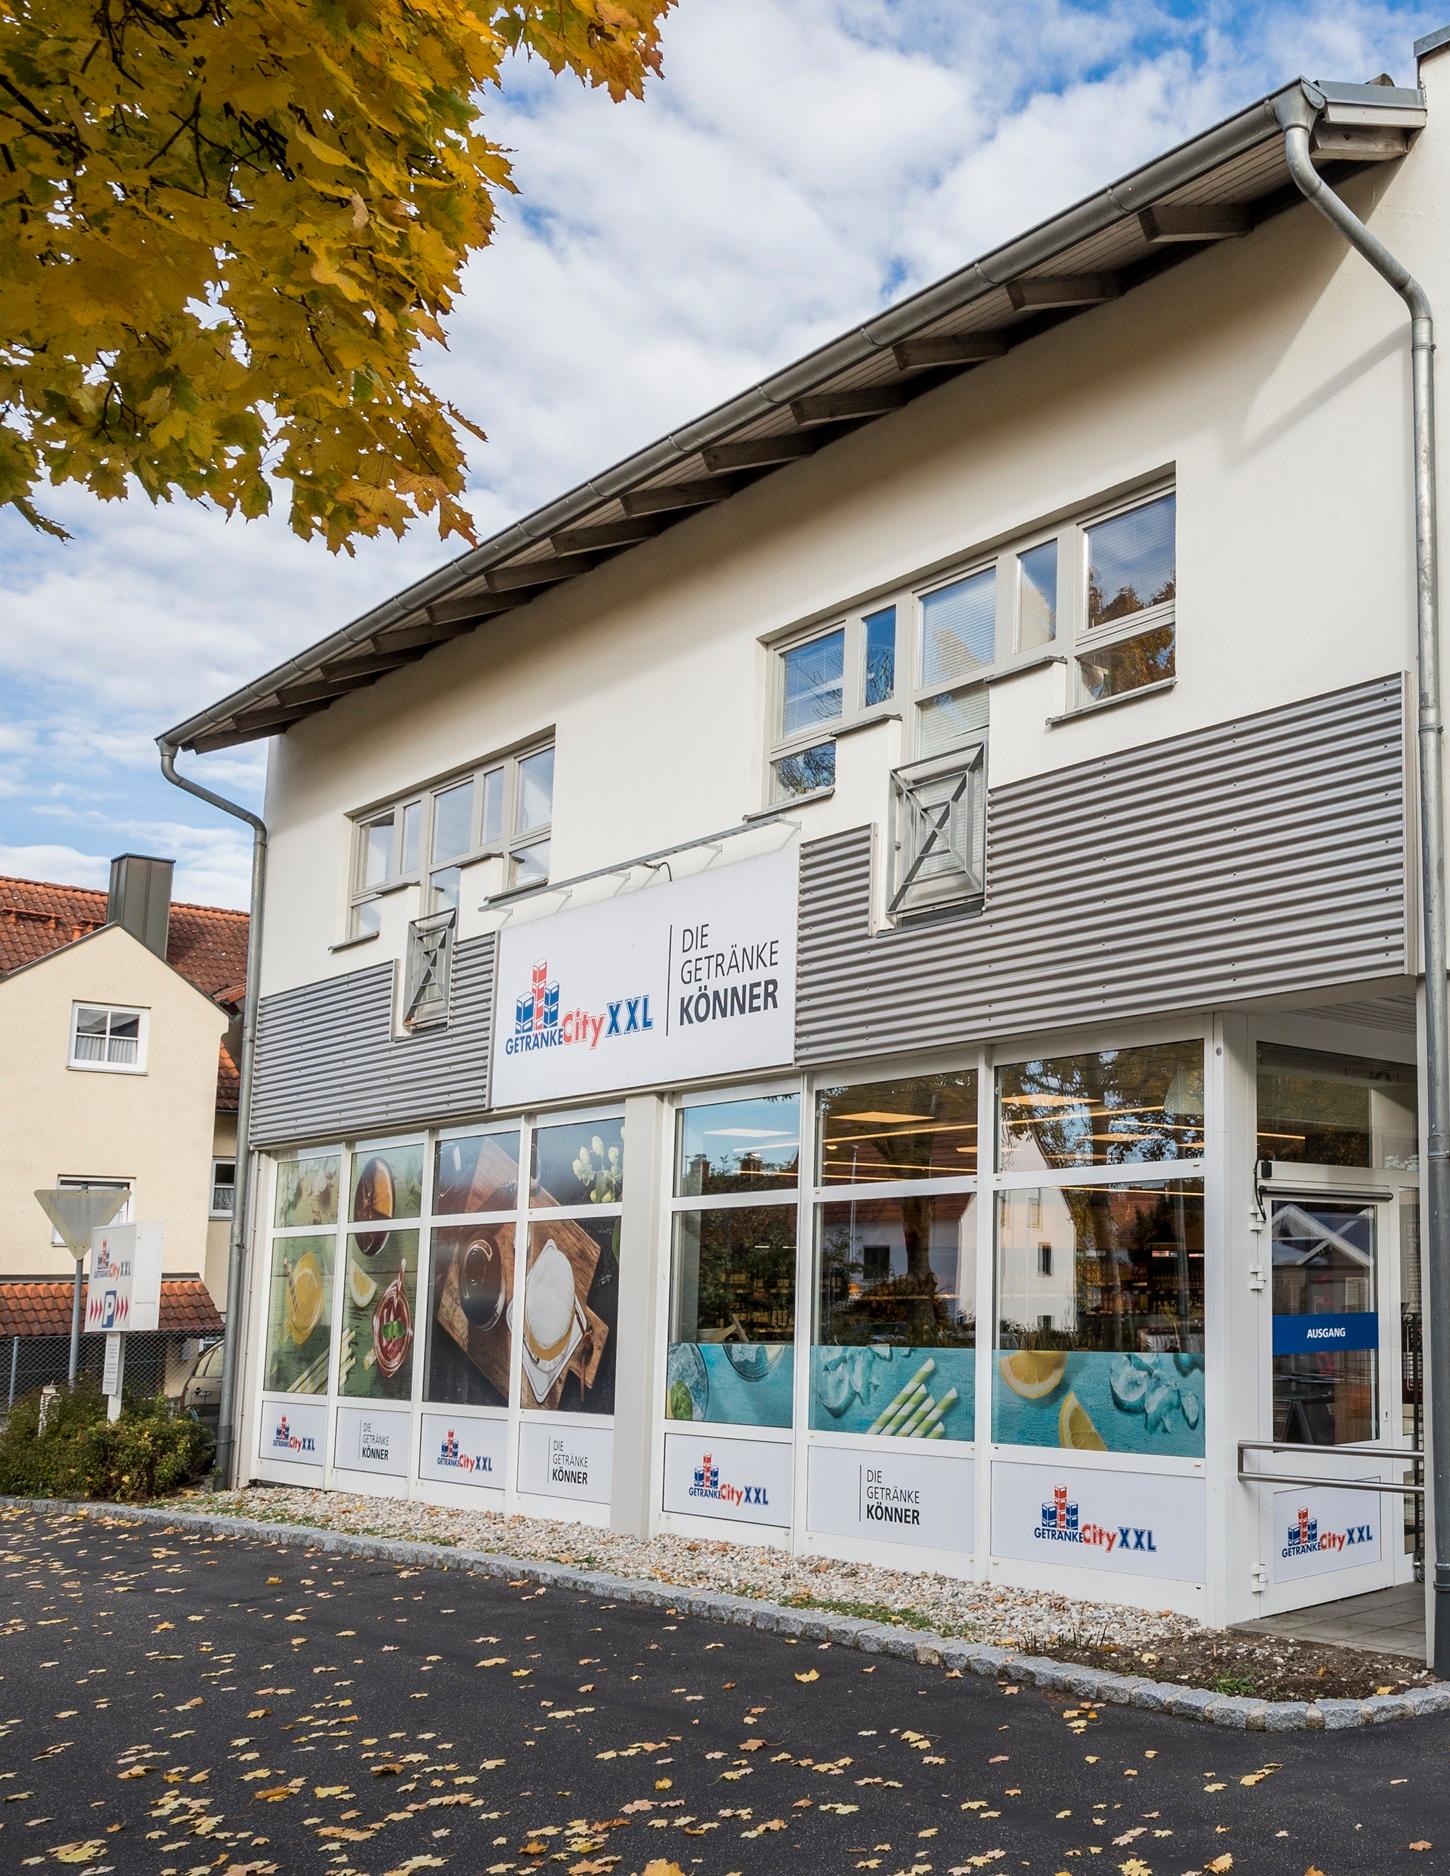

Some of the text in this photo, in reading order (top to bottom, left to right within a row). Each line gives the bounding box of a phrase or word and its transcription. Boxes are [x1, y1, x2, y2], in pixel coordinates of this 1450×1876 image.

[681, 923, 710, 953] DIE
[680, 940, 779, 985] GETRÄNKE
[679, 978, 779, 1026] KÖNNER
[505, 994, 654, 1056] GETRÄNKE City XXL
[1306, 1327, 1346, 1339] AUSGANG
[363, 1422, 372, 1433] DIE
[302, 1438, 315, 1452] XXL
[362, 1433, 390, 1447] GETRÄNKE
[553, 1440, 565, 1452] DIE
[362, 1446, 389, 1461] KÖNNER
[459, 1453, 475, 1473] City
[475, 1456, 492, 1472] XXL
[552, 1452, 588, 1469] GETRÄNKE
[552, 1466, 588, 1485] KÖNNER
[866, 1469, 882, 1484] DIE
[688, 1484, 769, 1506] GETRÄNKE City XXL
[866, 1485, 920, 1504] GETRÄNKE
[866, 1502, 920, 1526] KÖNNER
[1034, 1523, 1158, 1554] GETRÄNKE City XXL
[1281, 1524, 1374, 1559] GETRÄNKE City XXL
